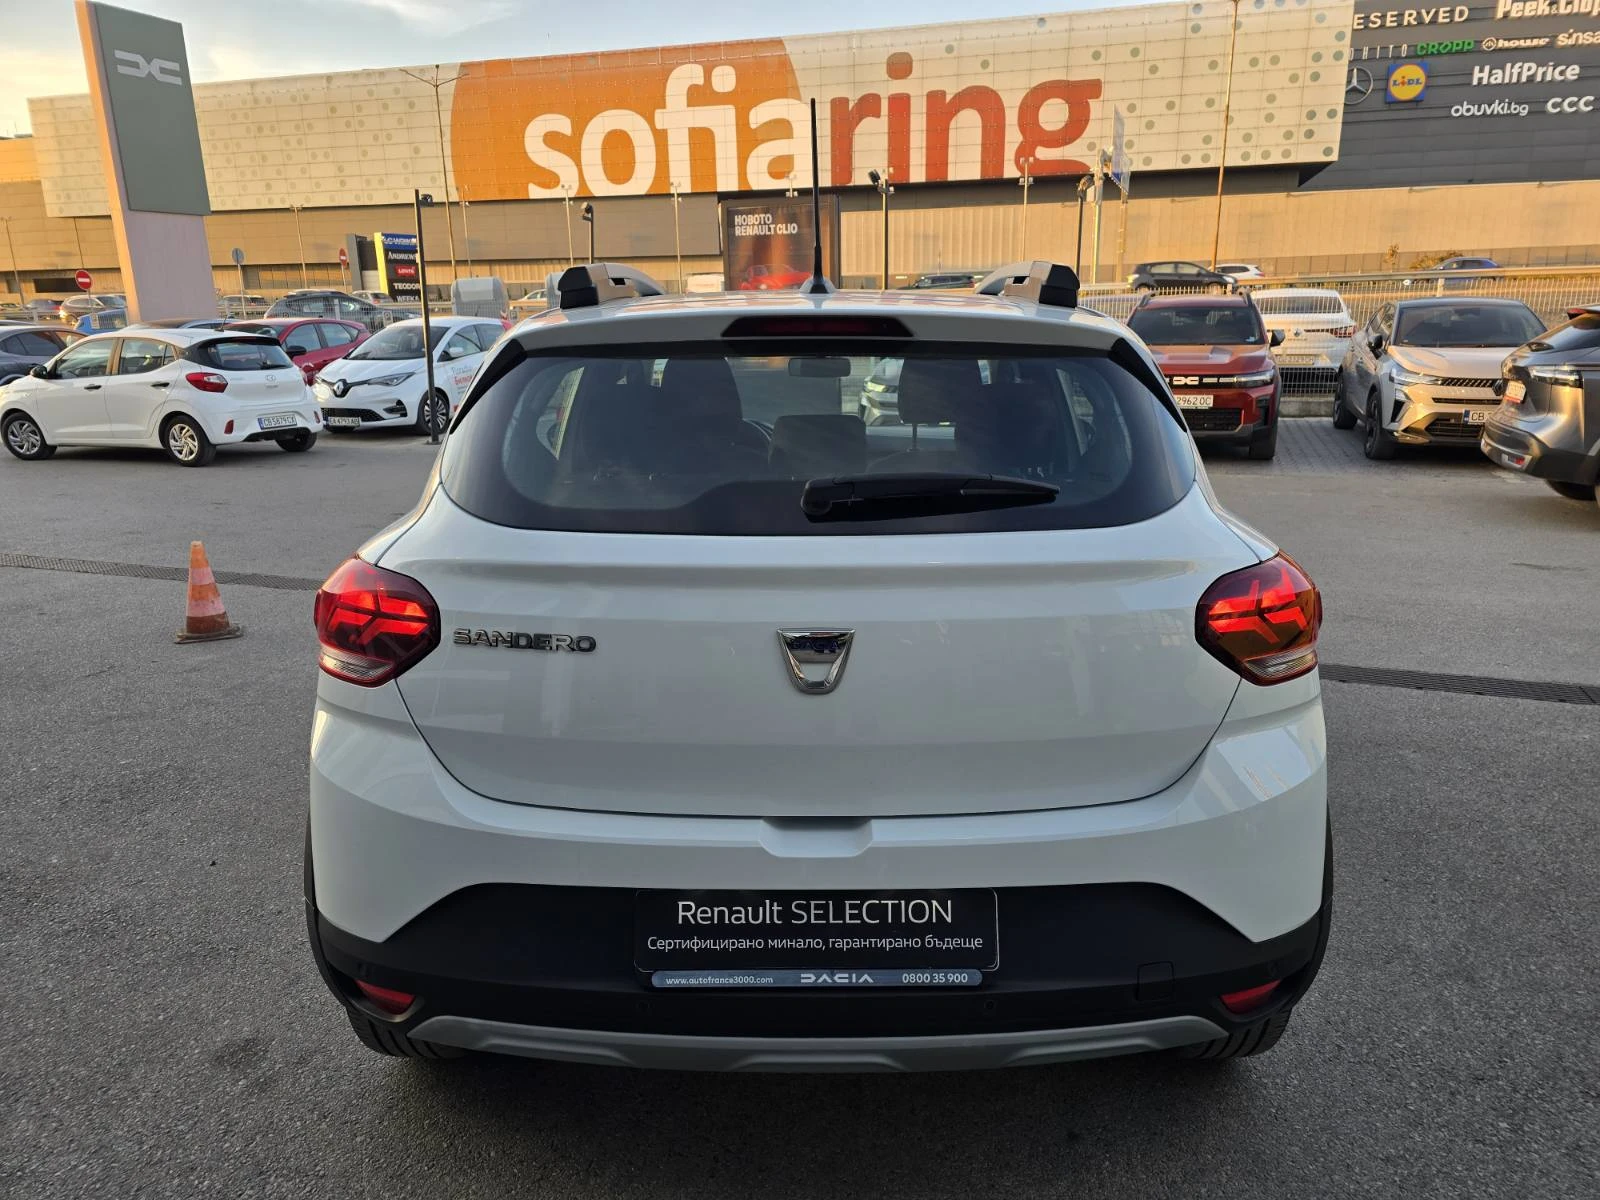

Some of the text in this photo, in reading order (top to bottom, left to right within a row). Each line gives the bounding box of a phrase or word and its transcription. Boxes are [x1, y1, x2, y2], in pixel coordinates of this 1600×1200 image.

[1353, 5, 1469, 29] ESERVED
[1416, 39, 1475, 56] CROPP
[1472, 61, 1580, 86] HalfPrice
[1451, 98, 1529, 117] obuvki.bg
[1546, 95, 1595, 113] CCC
[734, 223, 798, 237] RENAULT CLIO
[1176, 396, 1198, 406] 2962
[1471, 412, 1485, 421] CB
[453, 628, 597, 653] SANDERO
[677, 899, 952, 925] Renault SELECTION
[647, 934, 983, 952] Сертифицирано минало, гарантирано бъдеще
[666, 975, 774, 985] www.autofrance3000.com
[902, 973, 931, 983] 0800
[932, 973, 946, 983] 35
[947, 973, 968, 983] 900
